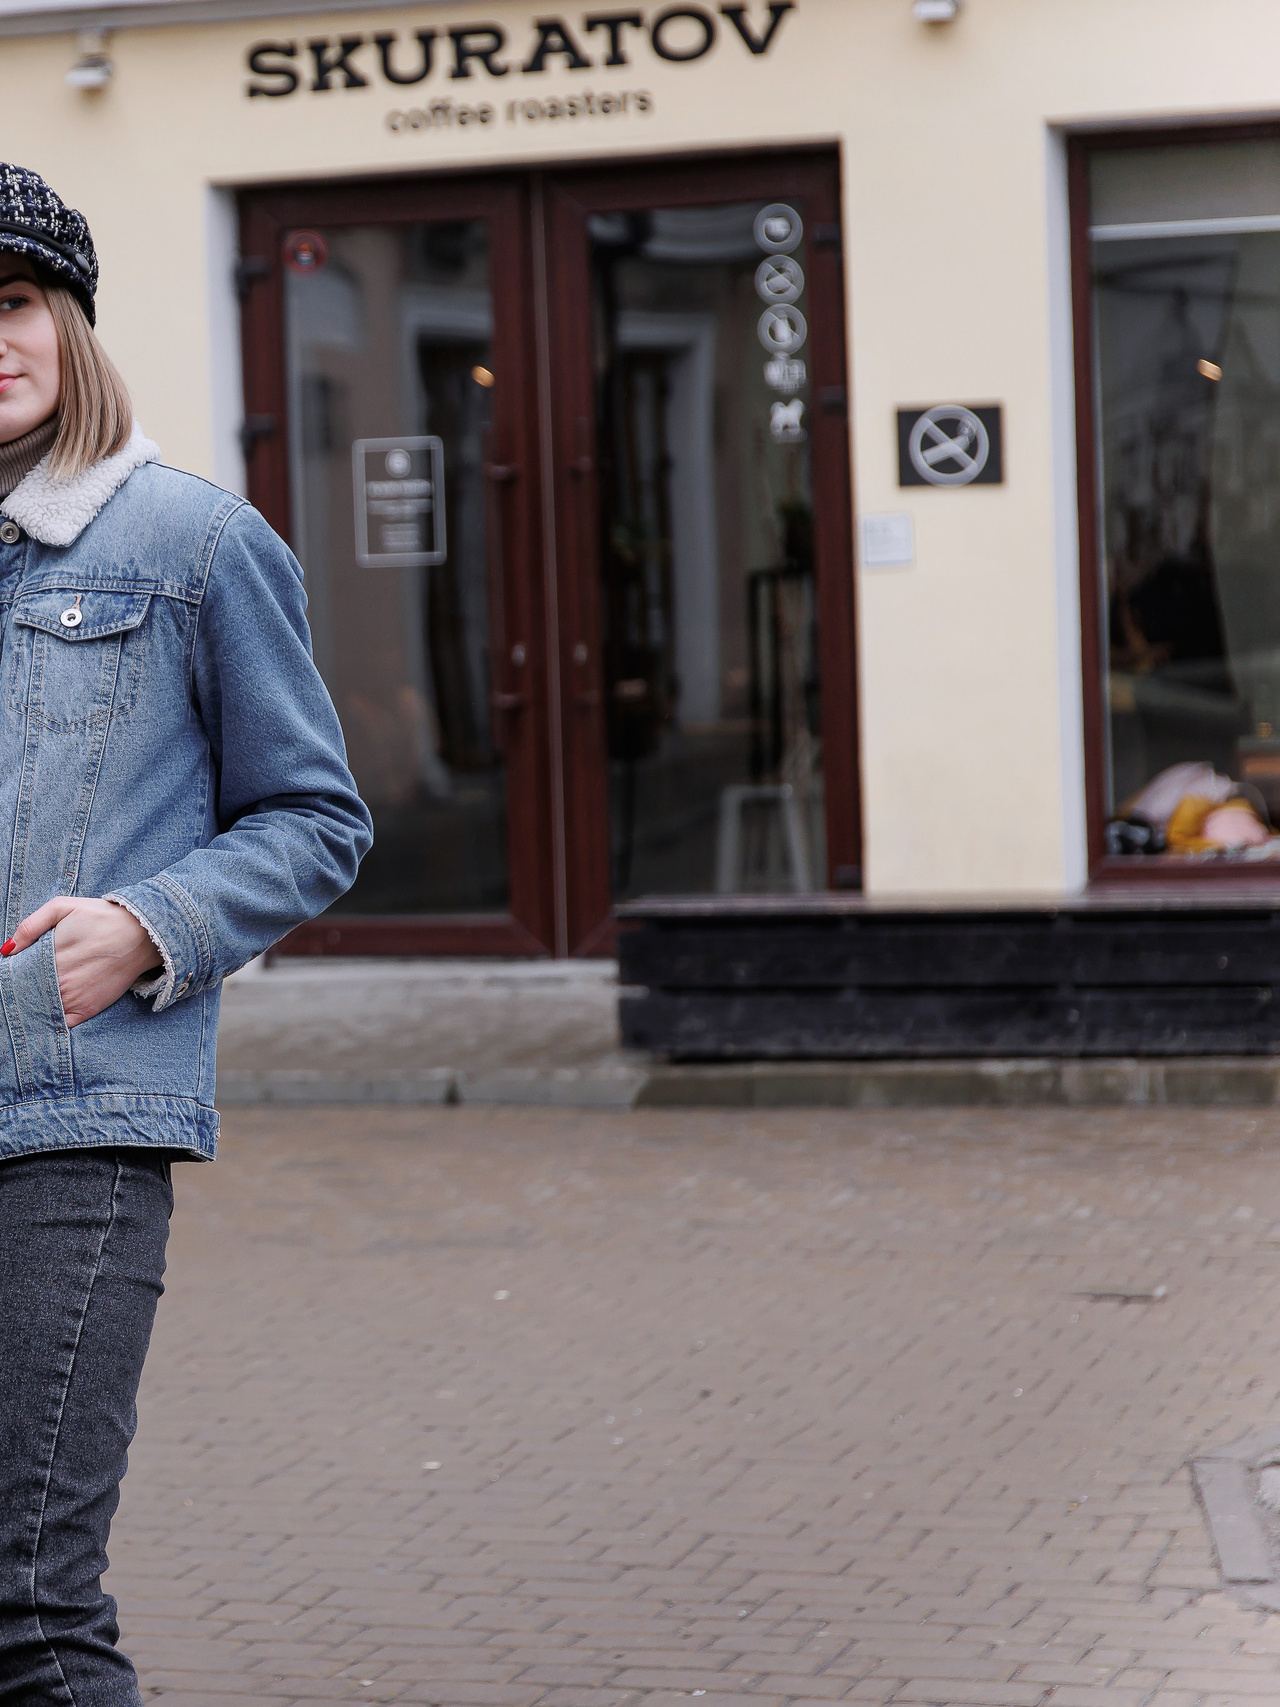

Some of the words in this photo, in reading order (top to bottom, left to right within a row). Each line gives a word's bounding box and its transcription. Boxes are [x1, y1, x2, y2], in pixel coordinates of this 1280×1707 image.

[247, 1, 797, 98] SKURATOV
[386, 97, 495, 131] coffee
[506, 87, 652, 123] roasters
